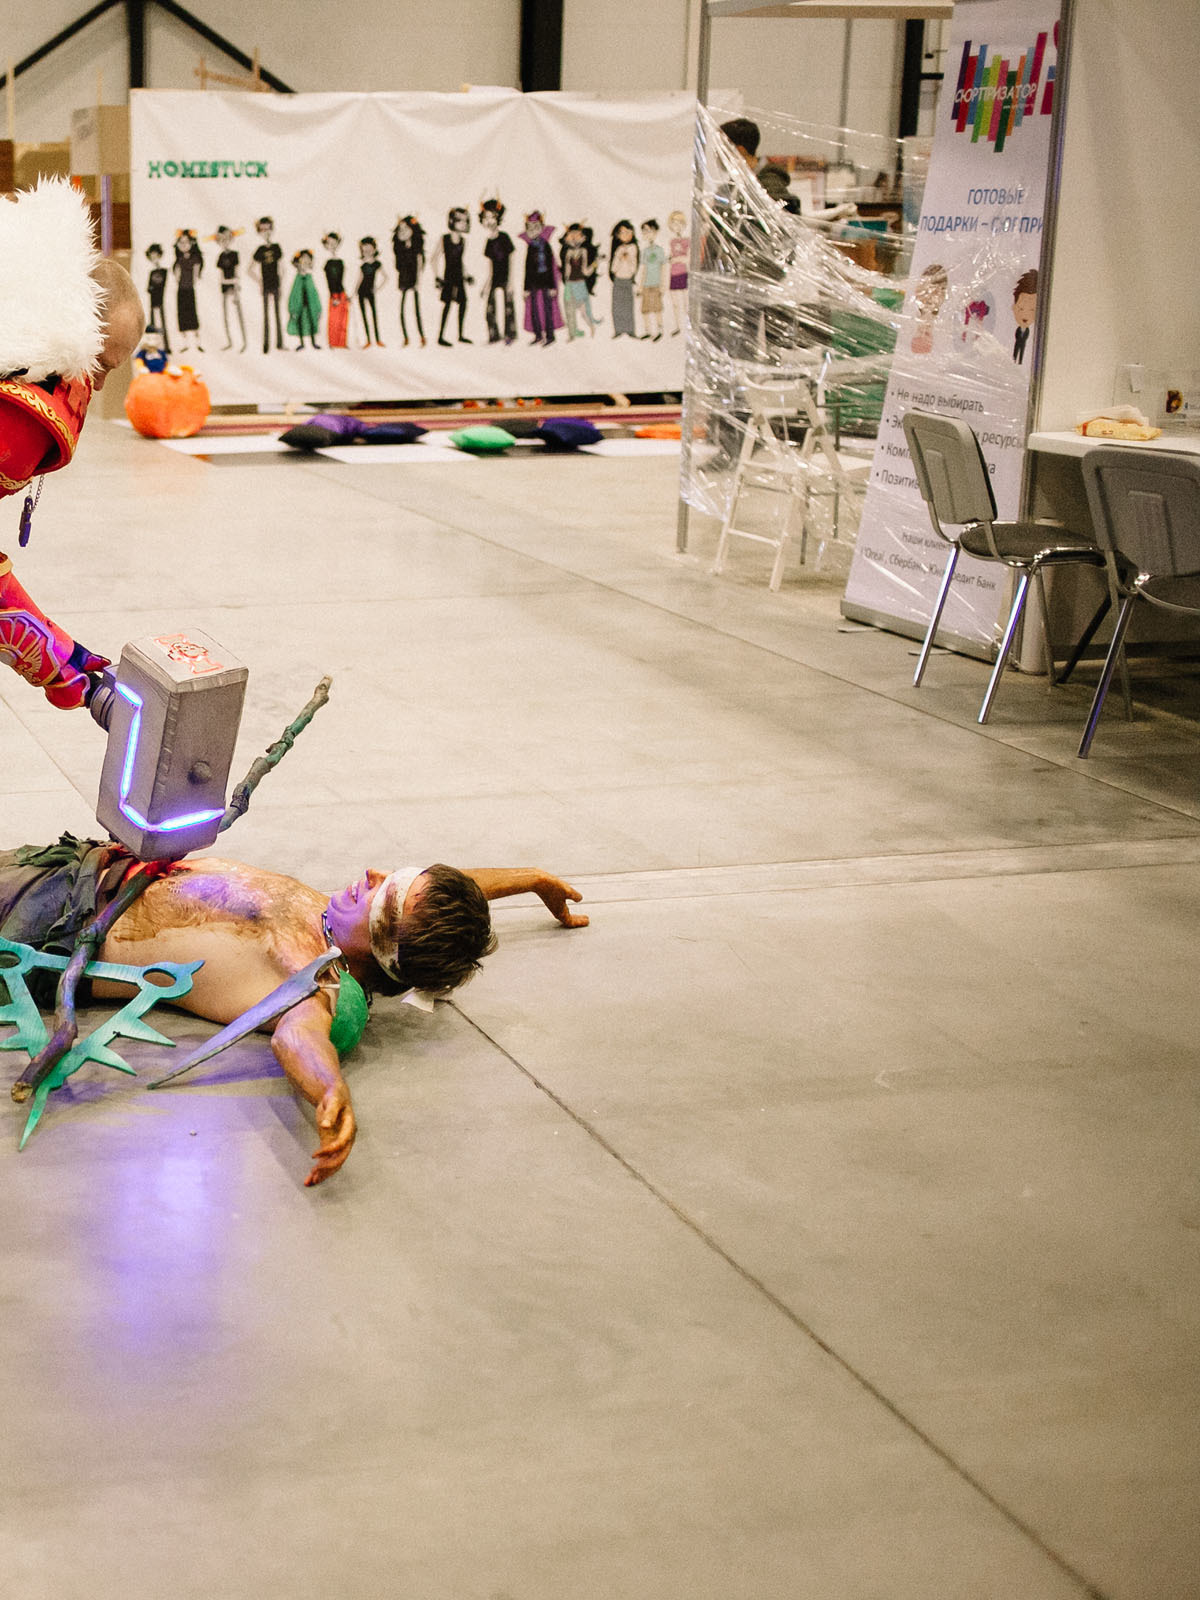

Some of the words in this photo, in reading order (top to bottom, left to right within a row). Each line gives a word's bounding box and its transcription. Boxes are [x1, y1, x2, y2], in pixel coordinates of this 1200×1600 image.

[966, 188, 1025, 205] ГОТОВЫЕ
[920, 216, 979, 235] ПОДАРКИ
[912, 393, 936, 406] надо
[937, 394, 984, 412] выбирать
